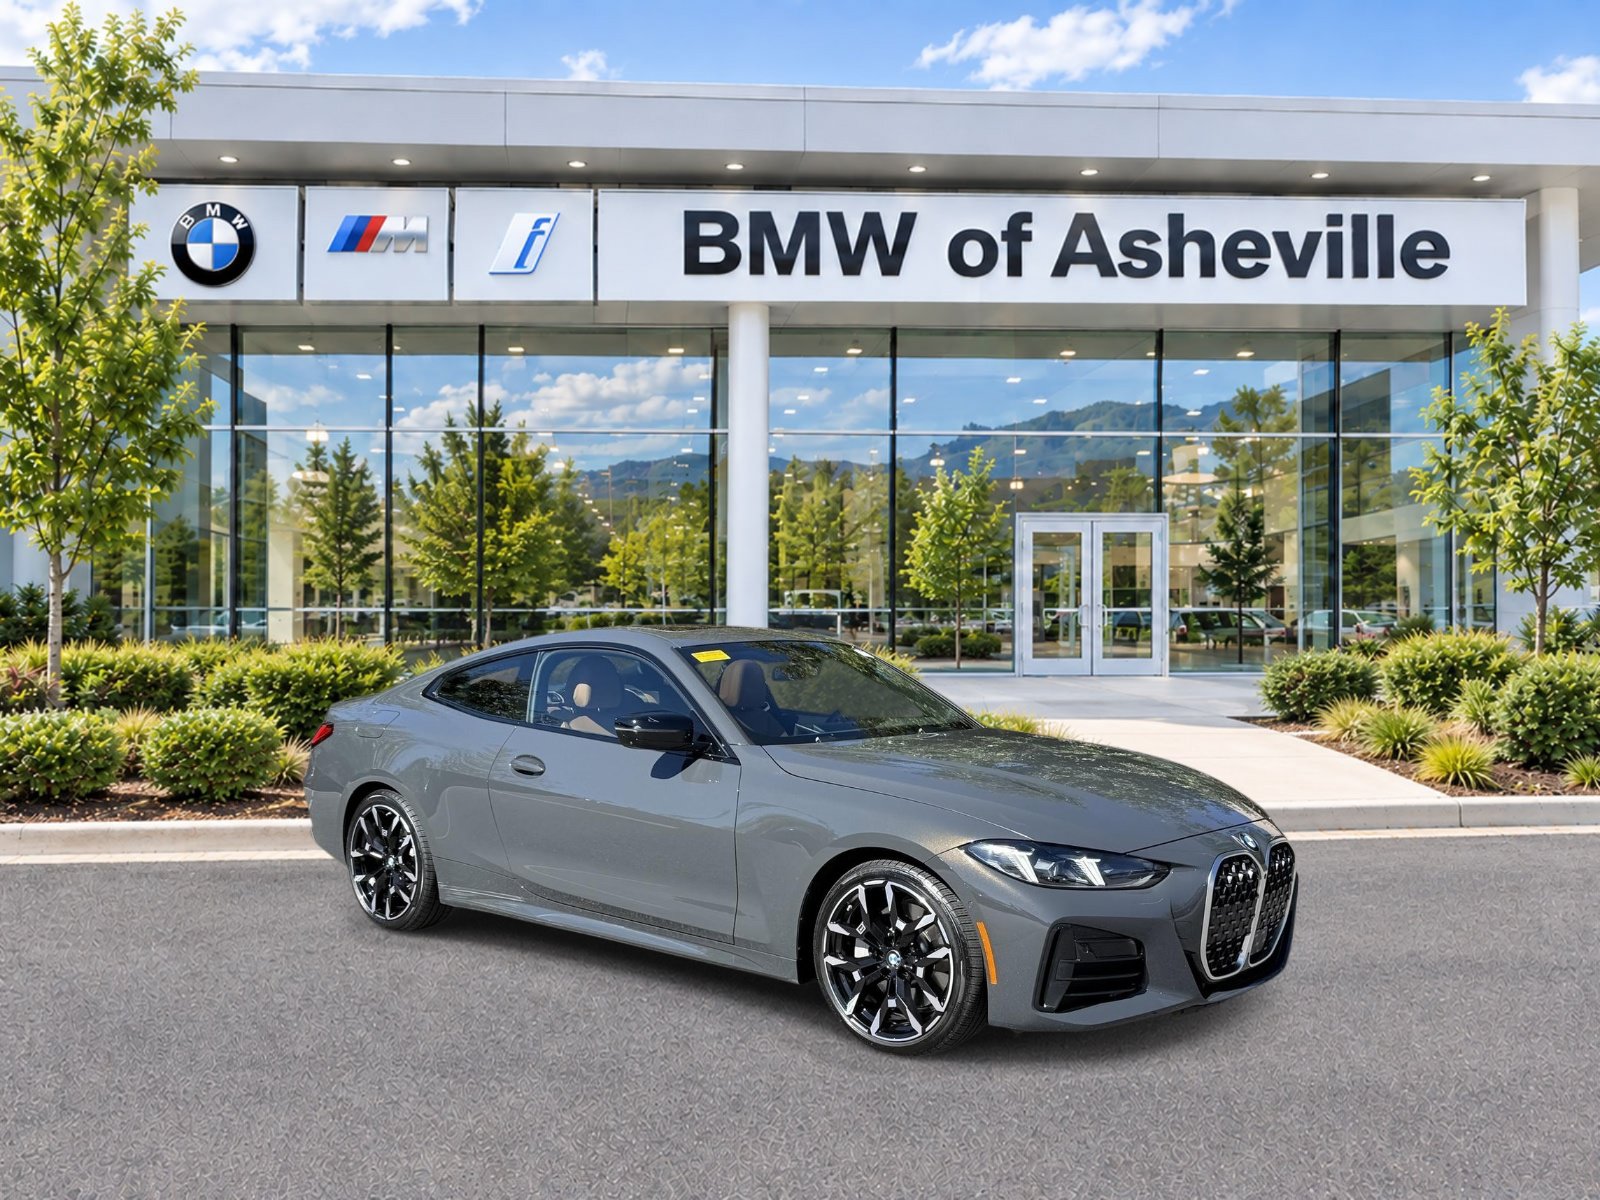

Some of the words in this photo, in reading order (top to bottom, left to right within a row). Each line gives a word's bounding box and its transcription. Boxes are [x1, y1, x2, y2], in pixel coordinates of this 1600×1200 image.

[180, 203, 248, 230] BMW
[684, 211, 917, 276] BMW
[948, 212, 1032, 277] of
[1051, 213, 1450, 279] Asheville
